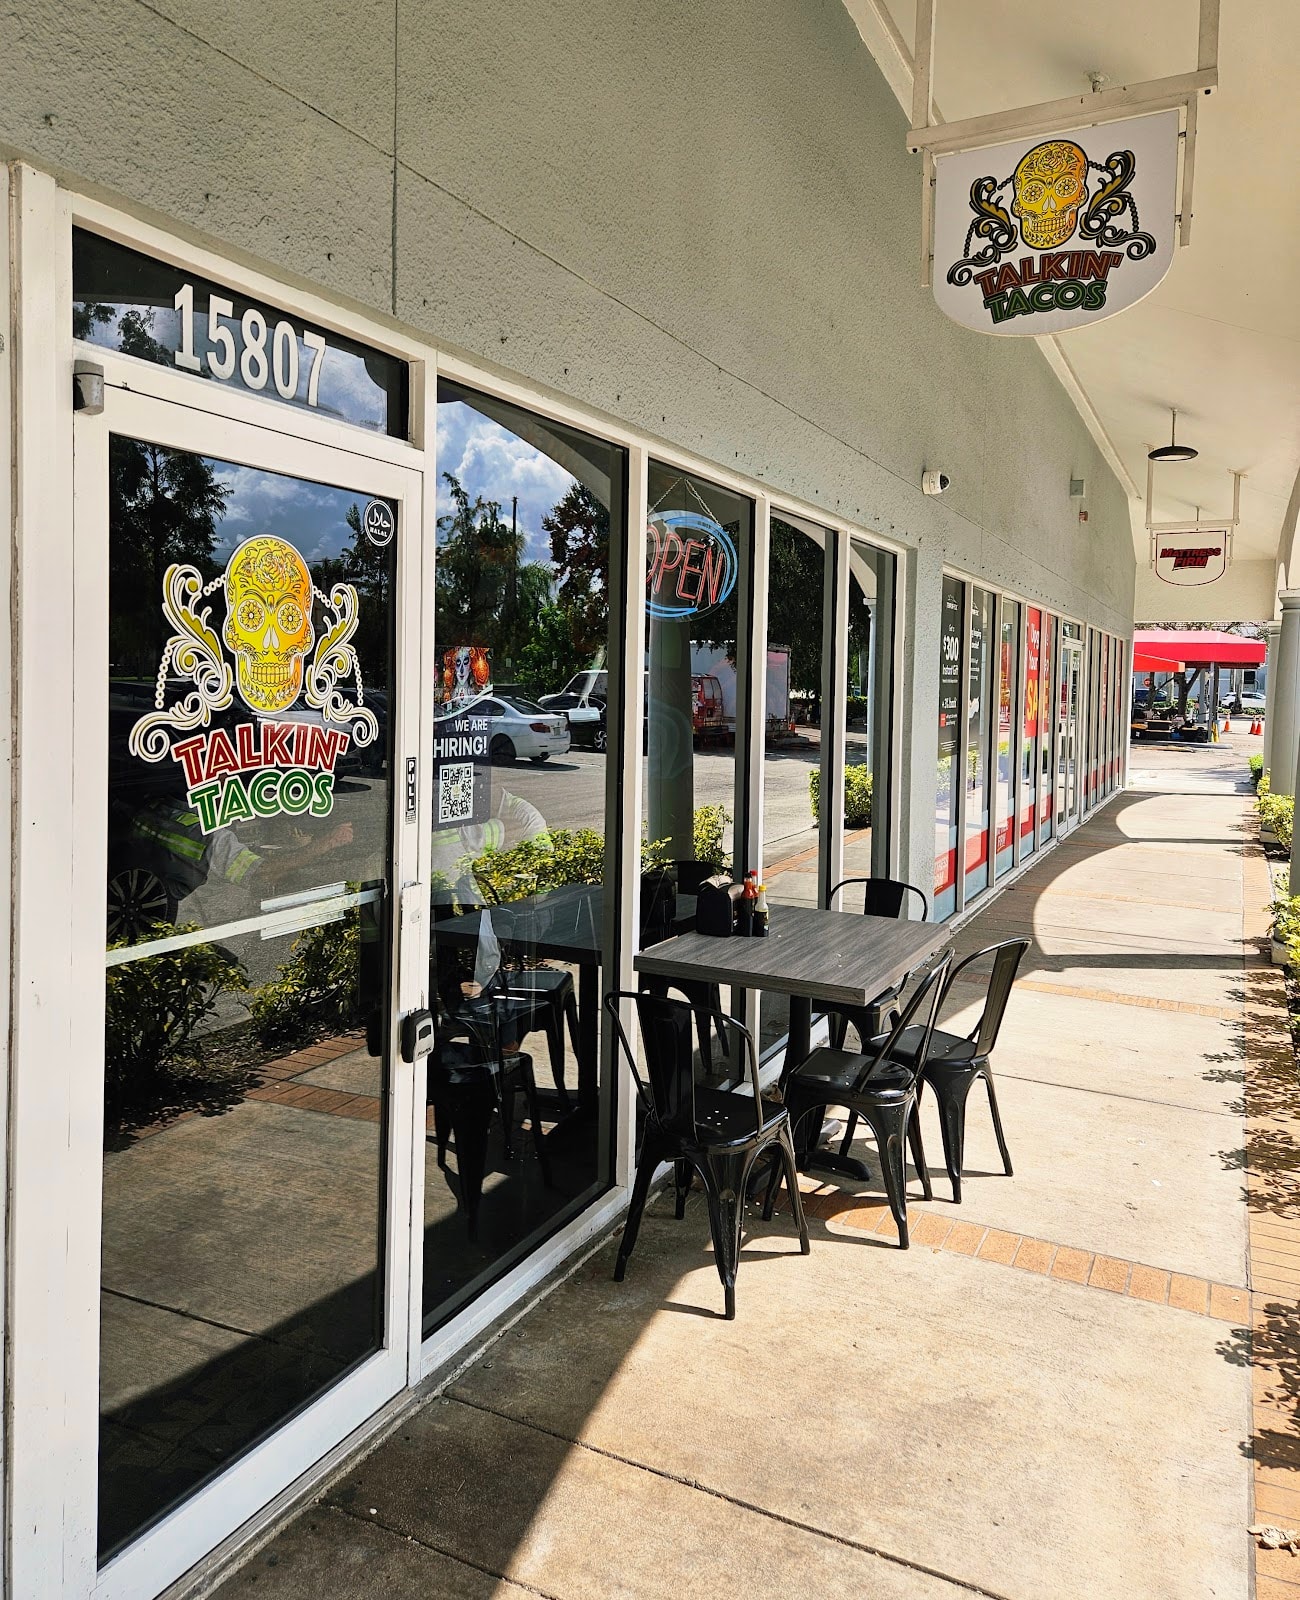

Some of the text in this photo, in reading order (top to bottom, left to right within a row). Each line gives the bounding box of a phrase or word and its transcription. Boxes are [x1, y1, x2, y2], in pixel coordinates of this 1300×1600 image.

[973, 250, 1124, 298] TALKIN'
[983, 280, 1108, 324] TACOS
[174, 283, 327, 407] 15807
[1160, 547, 1222, 558] MATTRESS
[1173, 556, 1209, 568] FIRM
[943, 634, 959, 661] $300
[454, 718, 488, 733] WE ARE
[170, 721, 350, 790] TALKIN'
[433, 735, 488, 759] HIRING!
[186, 767, 336, 836] TACOS
